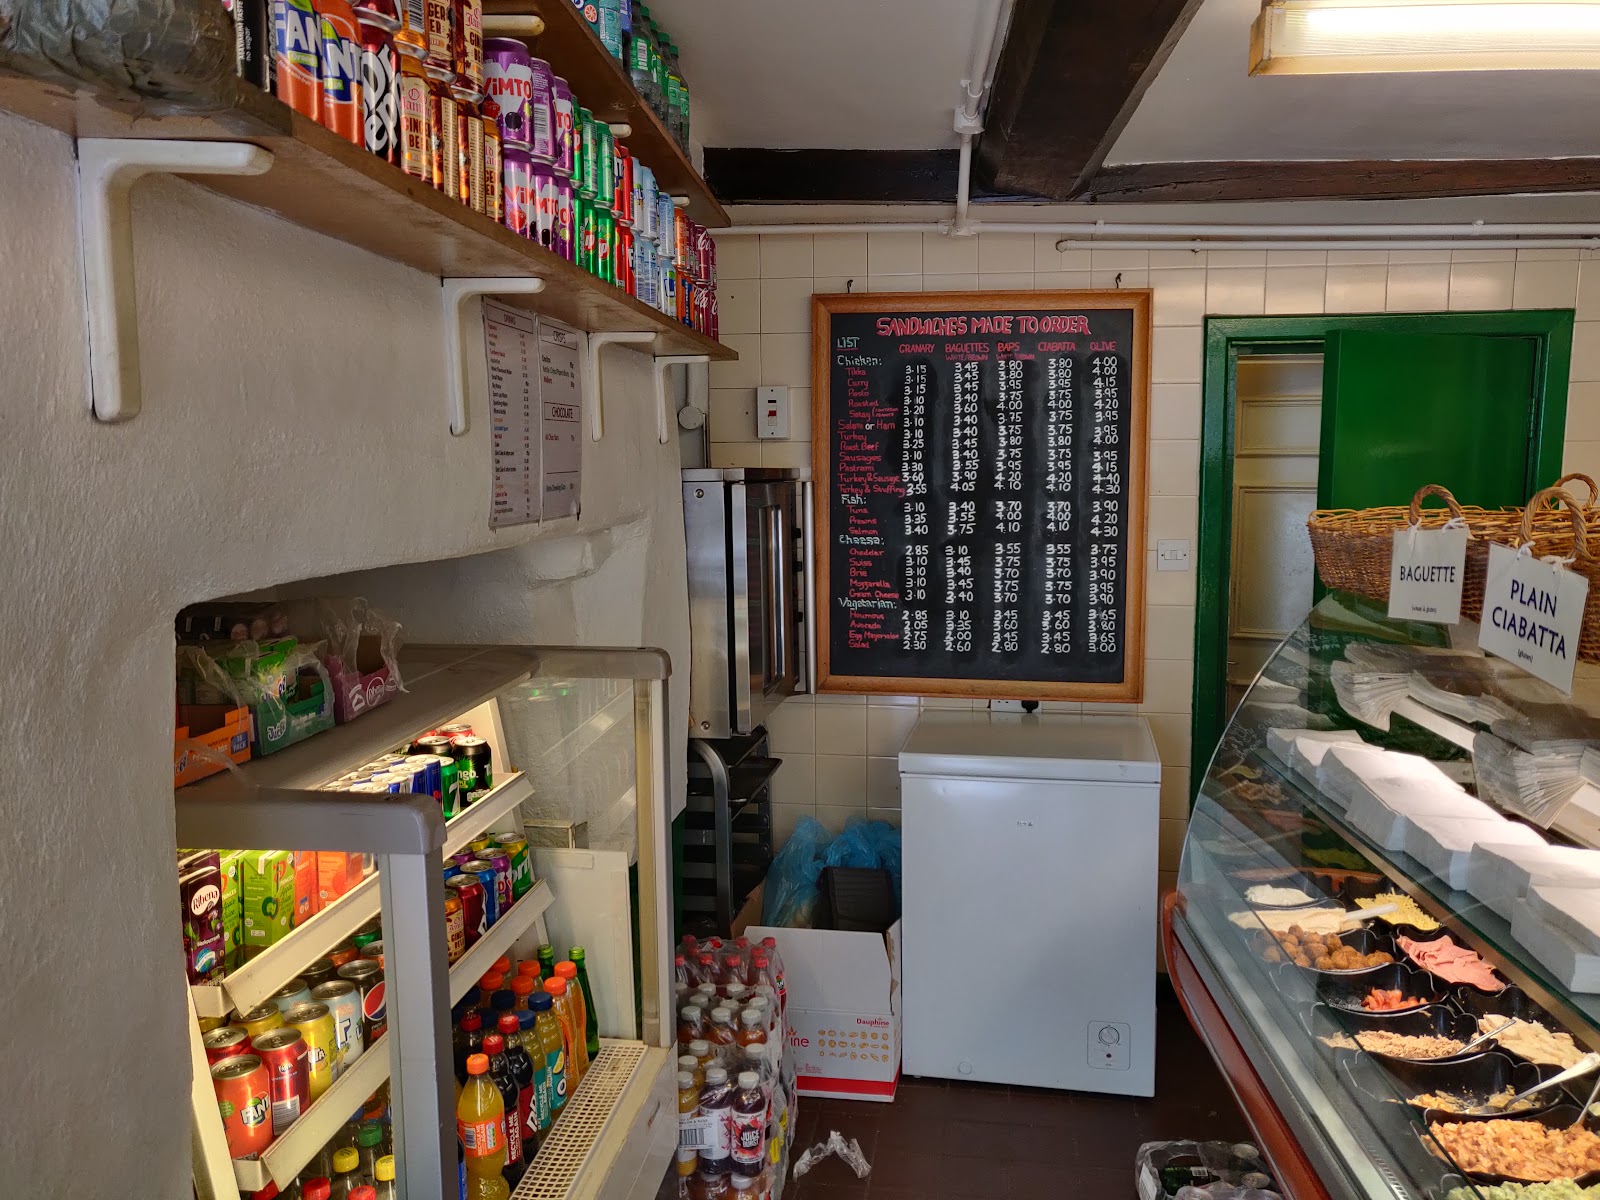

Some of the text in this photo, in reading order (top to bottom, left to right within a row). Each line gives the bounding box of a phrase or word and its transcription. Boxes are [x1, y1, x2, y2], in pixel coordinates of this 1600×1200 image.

[875, 315, 1092, 337] SANDWICHES MADE TO ORDER
[836, 336, 860, 350] LIST
[898, 340, 1117, 355] GRANARY BAGUETTES BAPS CIABATTA OLIVE
[845, 356, 1118, 376] Tikka 3.15 3.80 3.80 4.00
[847, 370, 1023, 390] Curry 3.15 3.80
[903, 384, 927, 395] 3.15
[1048, 378, 1072, 389] 3.95
[848, 390, 1024, 408] Roasted 3.10 3.75
[551, 406, 573, 419] CHOCOLATE
[849, 410, 872, 422] Satay
[903, 405, 925, 416] 3.20
[1047, 399, 1072, 409] 4.00
[865, 423, 875, 431] or
[876, 419, 896, 430] Ham
[903, 417, 925, 428] 3.10
[997, 411, 1023, 425] 3.75
[837, 423, 1073, 444] Turkey 3.10 3.75
[861, 441, 880, 451] Beef
[902, 439, 925, 449] 3.25
[998, 435, 1022, 447] 3.80
[839, 448, 1118, 465] Sausages 3.10 3.75 3.95
[901, 462, 923, 472] 3.30
[995, 460, 1023, 472] 3.95
[901, 472, 924, 482] 3.60
[1045, 471, 1072, 483] 4.20
[837, 480, 1022, 498] Turkey & Stuffing 3.55 4.10
[841, 494, 867, 505] Fish:
[846, 500, 1119, 514] Tuna 3.10 3.70 3.90
[849, 511, 1022, 525] Prawns 3.35 4.00
[848, 521, 1070, 536] Salmon 3.40 4.10
[838, 534, 885, 546] Cheese:
[849, 542, 1118, 556] Cheddar 2.85 3.55 3.75
[849, 556, 1071, 568] Swiss 3.10 3.75
[849, 566, 1020, 579] Brie 3.10 3.70
[1399, 565, 1456, 583] BAGUETTE
[905, 577, 927, 588] 3.10
[1044, 581, 1073, 592] 3.75
[874, 590, 900, 599] Cheese
[904, 588, 926, 601] 3.10
[993, 592, 1018, 603] 3.70
[1510, 579, 1558, 618] PLAIN
[837, 597, 897, 611] Vegetarian:
[901, 610, 928, 620] 2.85
[1042, 609, 1071, 621] 3.45
[849, 619, 1018, 631] Avocado 3.60
[848, 630, 863, 641] Egg
[903, 631, 927, 641] 2.75
[1041, 631, 1071, 643] 3.45
[1491, 606, 1567, 660] CIABATTA
[848, 640, 1117, 653] Salad 2.30 2.60 2.80 3.00
[193, 888, 219, 911] Ribena
[856, 1018, 890, 1027] Dauphine
[508, 1115, 515, 1128] ME
